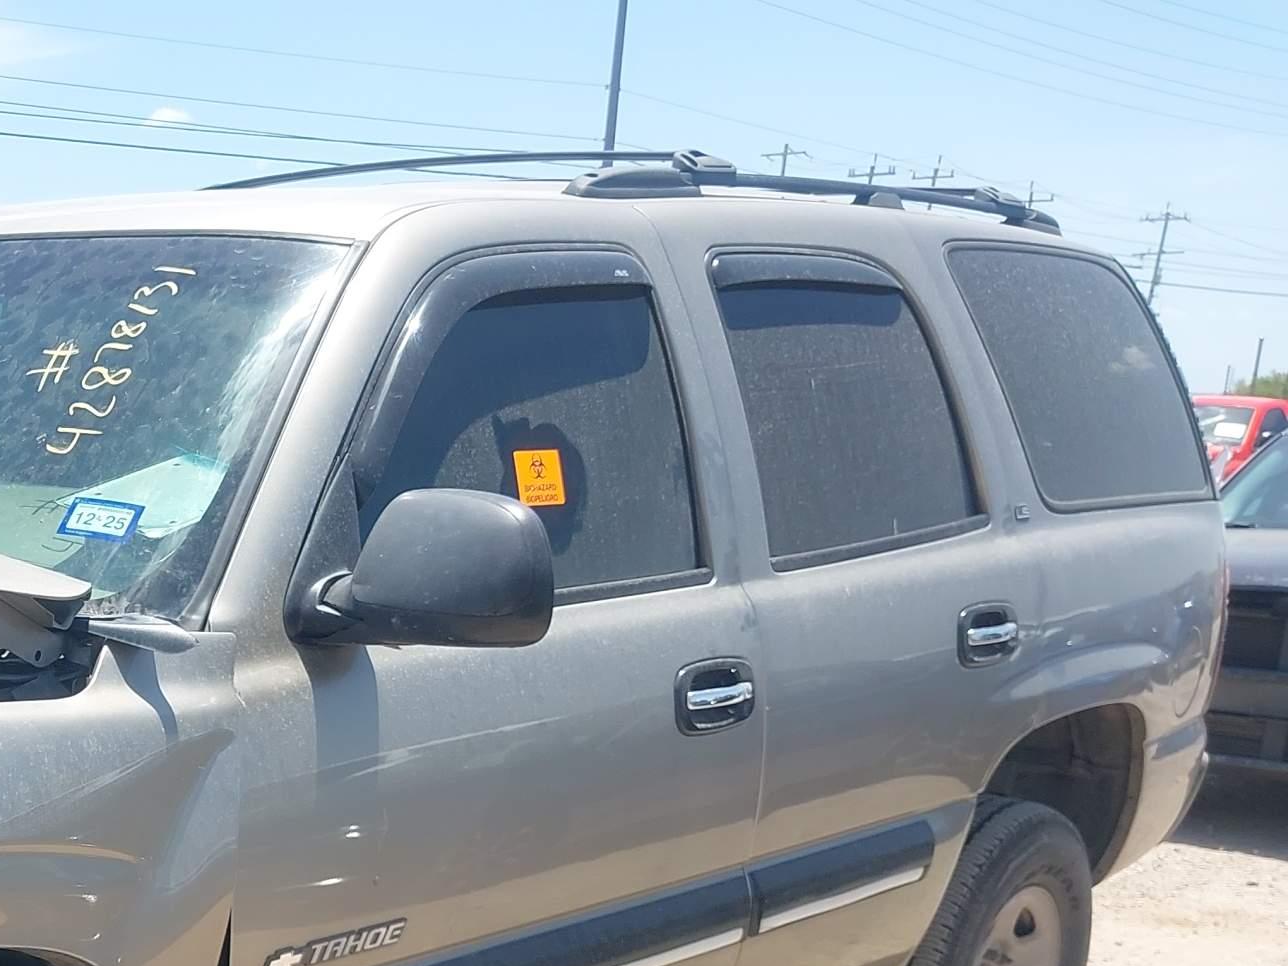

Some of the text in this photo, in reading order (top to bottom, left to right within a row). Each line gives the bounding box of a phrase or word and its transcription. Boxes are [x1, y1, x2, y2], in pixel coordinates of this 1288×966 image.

[25, 338, 80, 392] #
[45, 265, 197, 455] 42878131
[76, 511, 128, 530] 12 25
[309, 920, 406, 965] TAHOE
